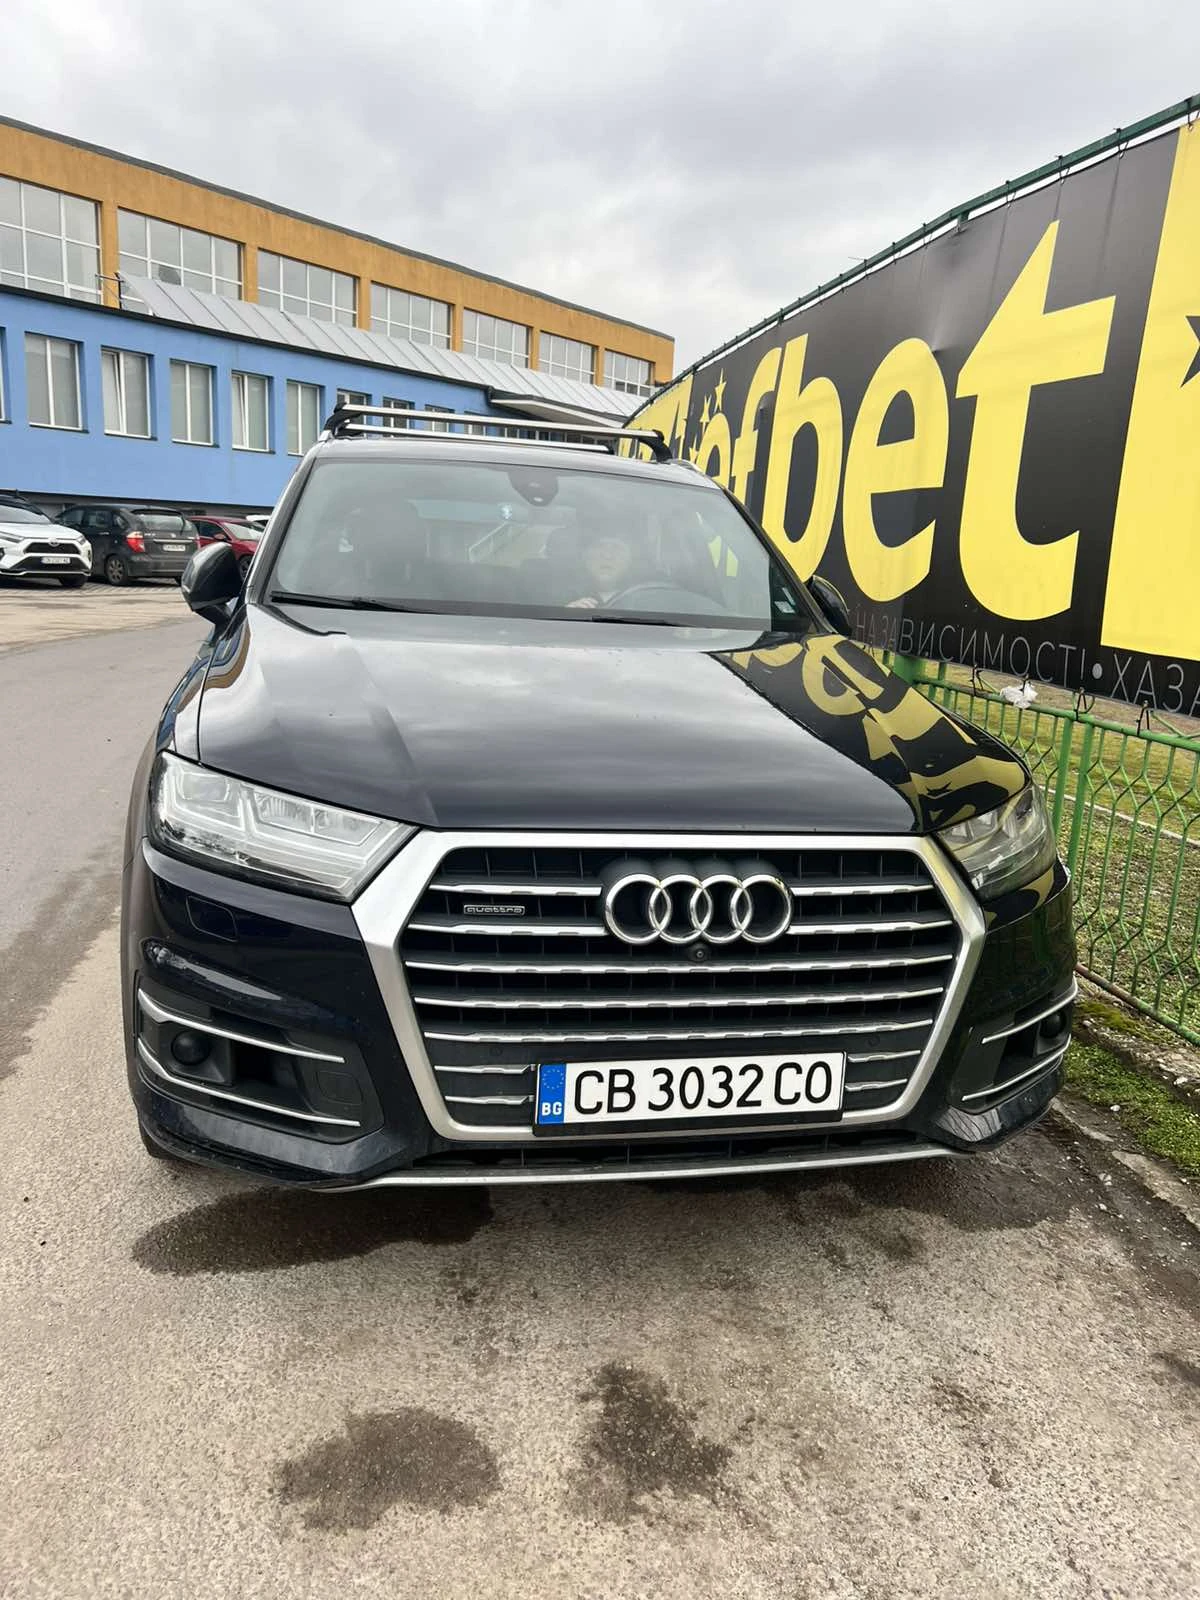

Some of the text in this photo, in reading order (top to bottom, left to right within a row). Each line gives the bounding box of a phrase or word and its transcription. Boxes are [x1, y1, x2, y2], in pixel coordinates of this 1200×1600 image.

[465, 906, 523, 914] quattro
[541, 1061, 832, 1116] BG CB 3032 CO
